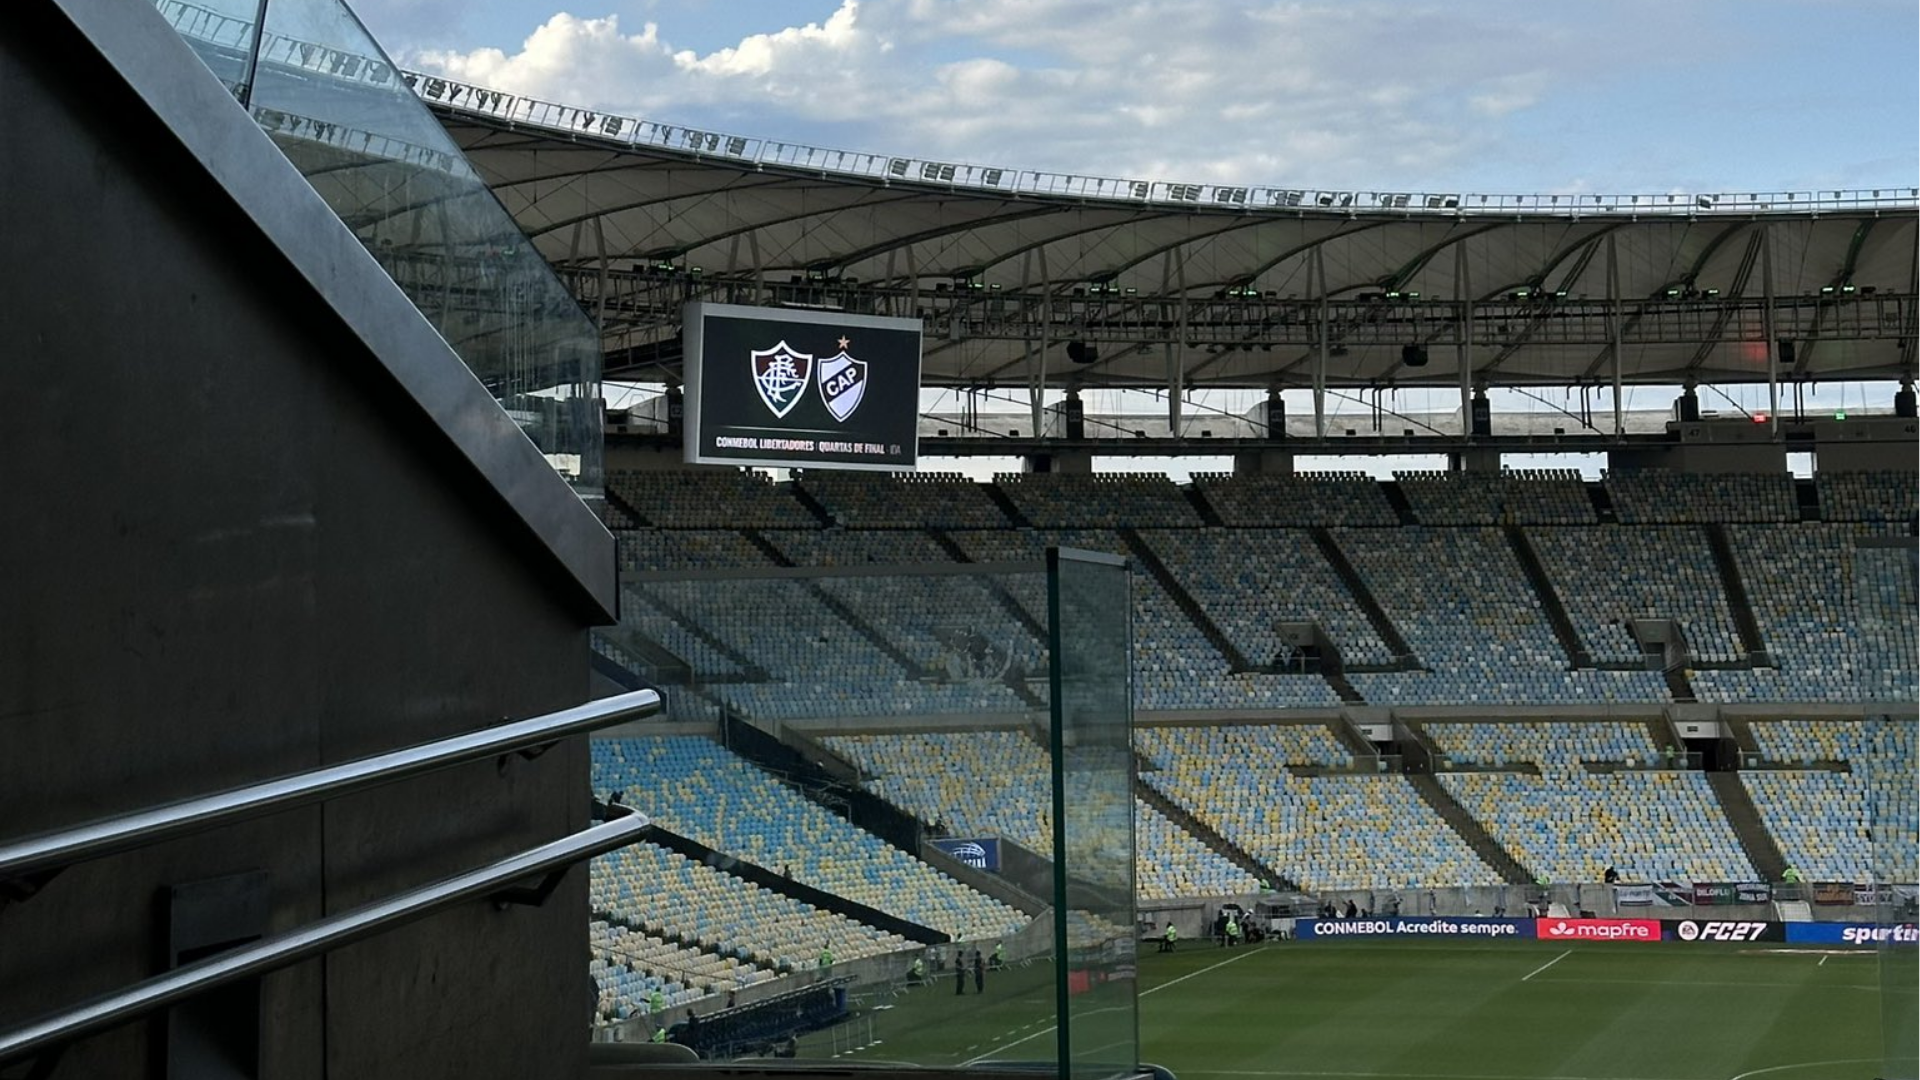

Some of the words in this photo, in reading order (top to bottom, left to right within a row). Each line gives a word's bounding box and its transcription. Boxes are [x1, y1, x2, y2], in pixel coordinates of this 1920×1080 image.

[825, 366, 858, 397] CAP
[716, 436, 758, 449] CONMEBOL
[759, 438, 814, 451] LIBERTADORES
[819, 441, 852, 453] QUARTAS
[853, 443, 864, 454] DE
[864, 443, 885, 454] FINAL
[1314, 921, 1394, 935] CONMEBOL
[1396, 919, 1458, 934] Acredite
[1577, 923, 1649, 939] mapfre
